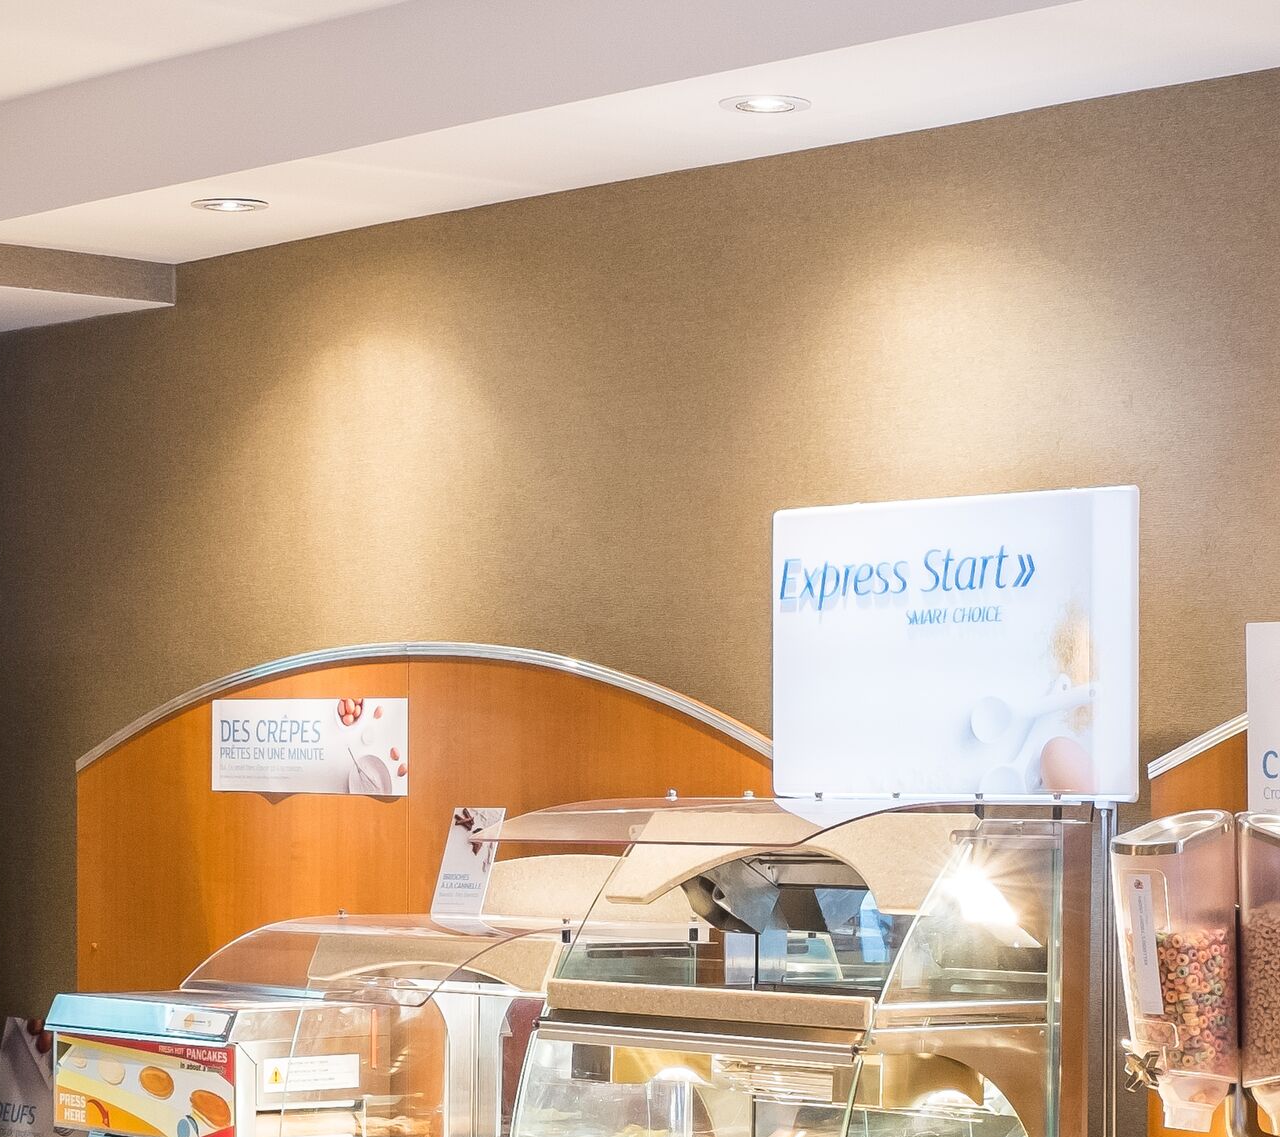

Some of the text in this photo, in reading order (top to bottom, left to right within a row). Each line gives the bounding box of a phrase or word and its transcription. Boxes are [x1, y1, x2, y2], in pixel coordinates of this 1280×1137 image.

[779, 545, 1009, 611] Express Start
[905, 605, 1003, 625] SMART CHOICE
[220, 714, 322, 743] DES CRÊPES
[220, 744, 325, 761] PRÊTES EN UNE MINUTE
[186, 1047, 228, 1063] PANCAKES
[60, 1092, 86, 1108] PRESS
[64, 1108, 87, 1122] HERE
